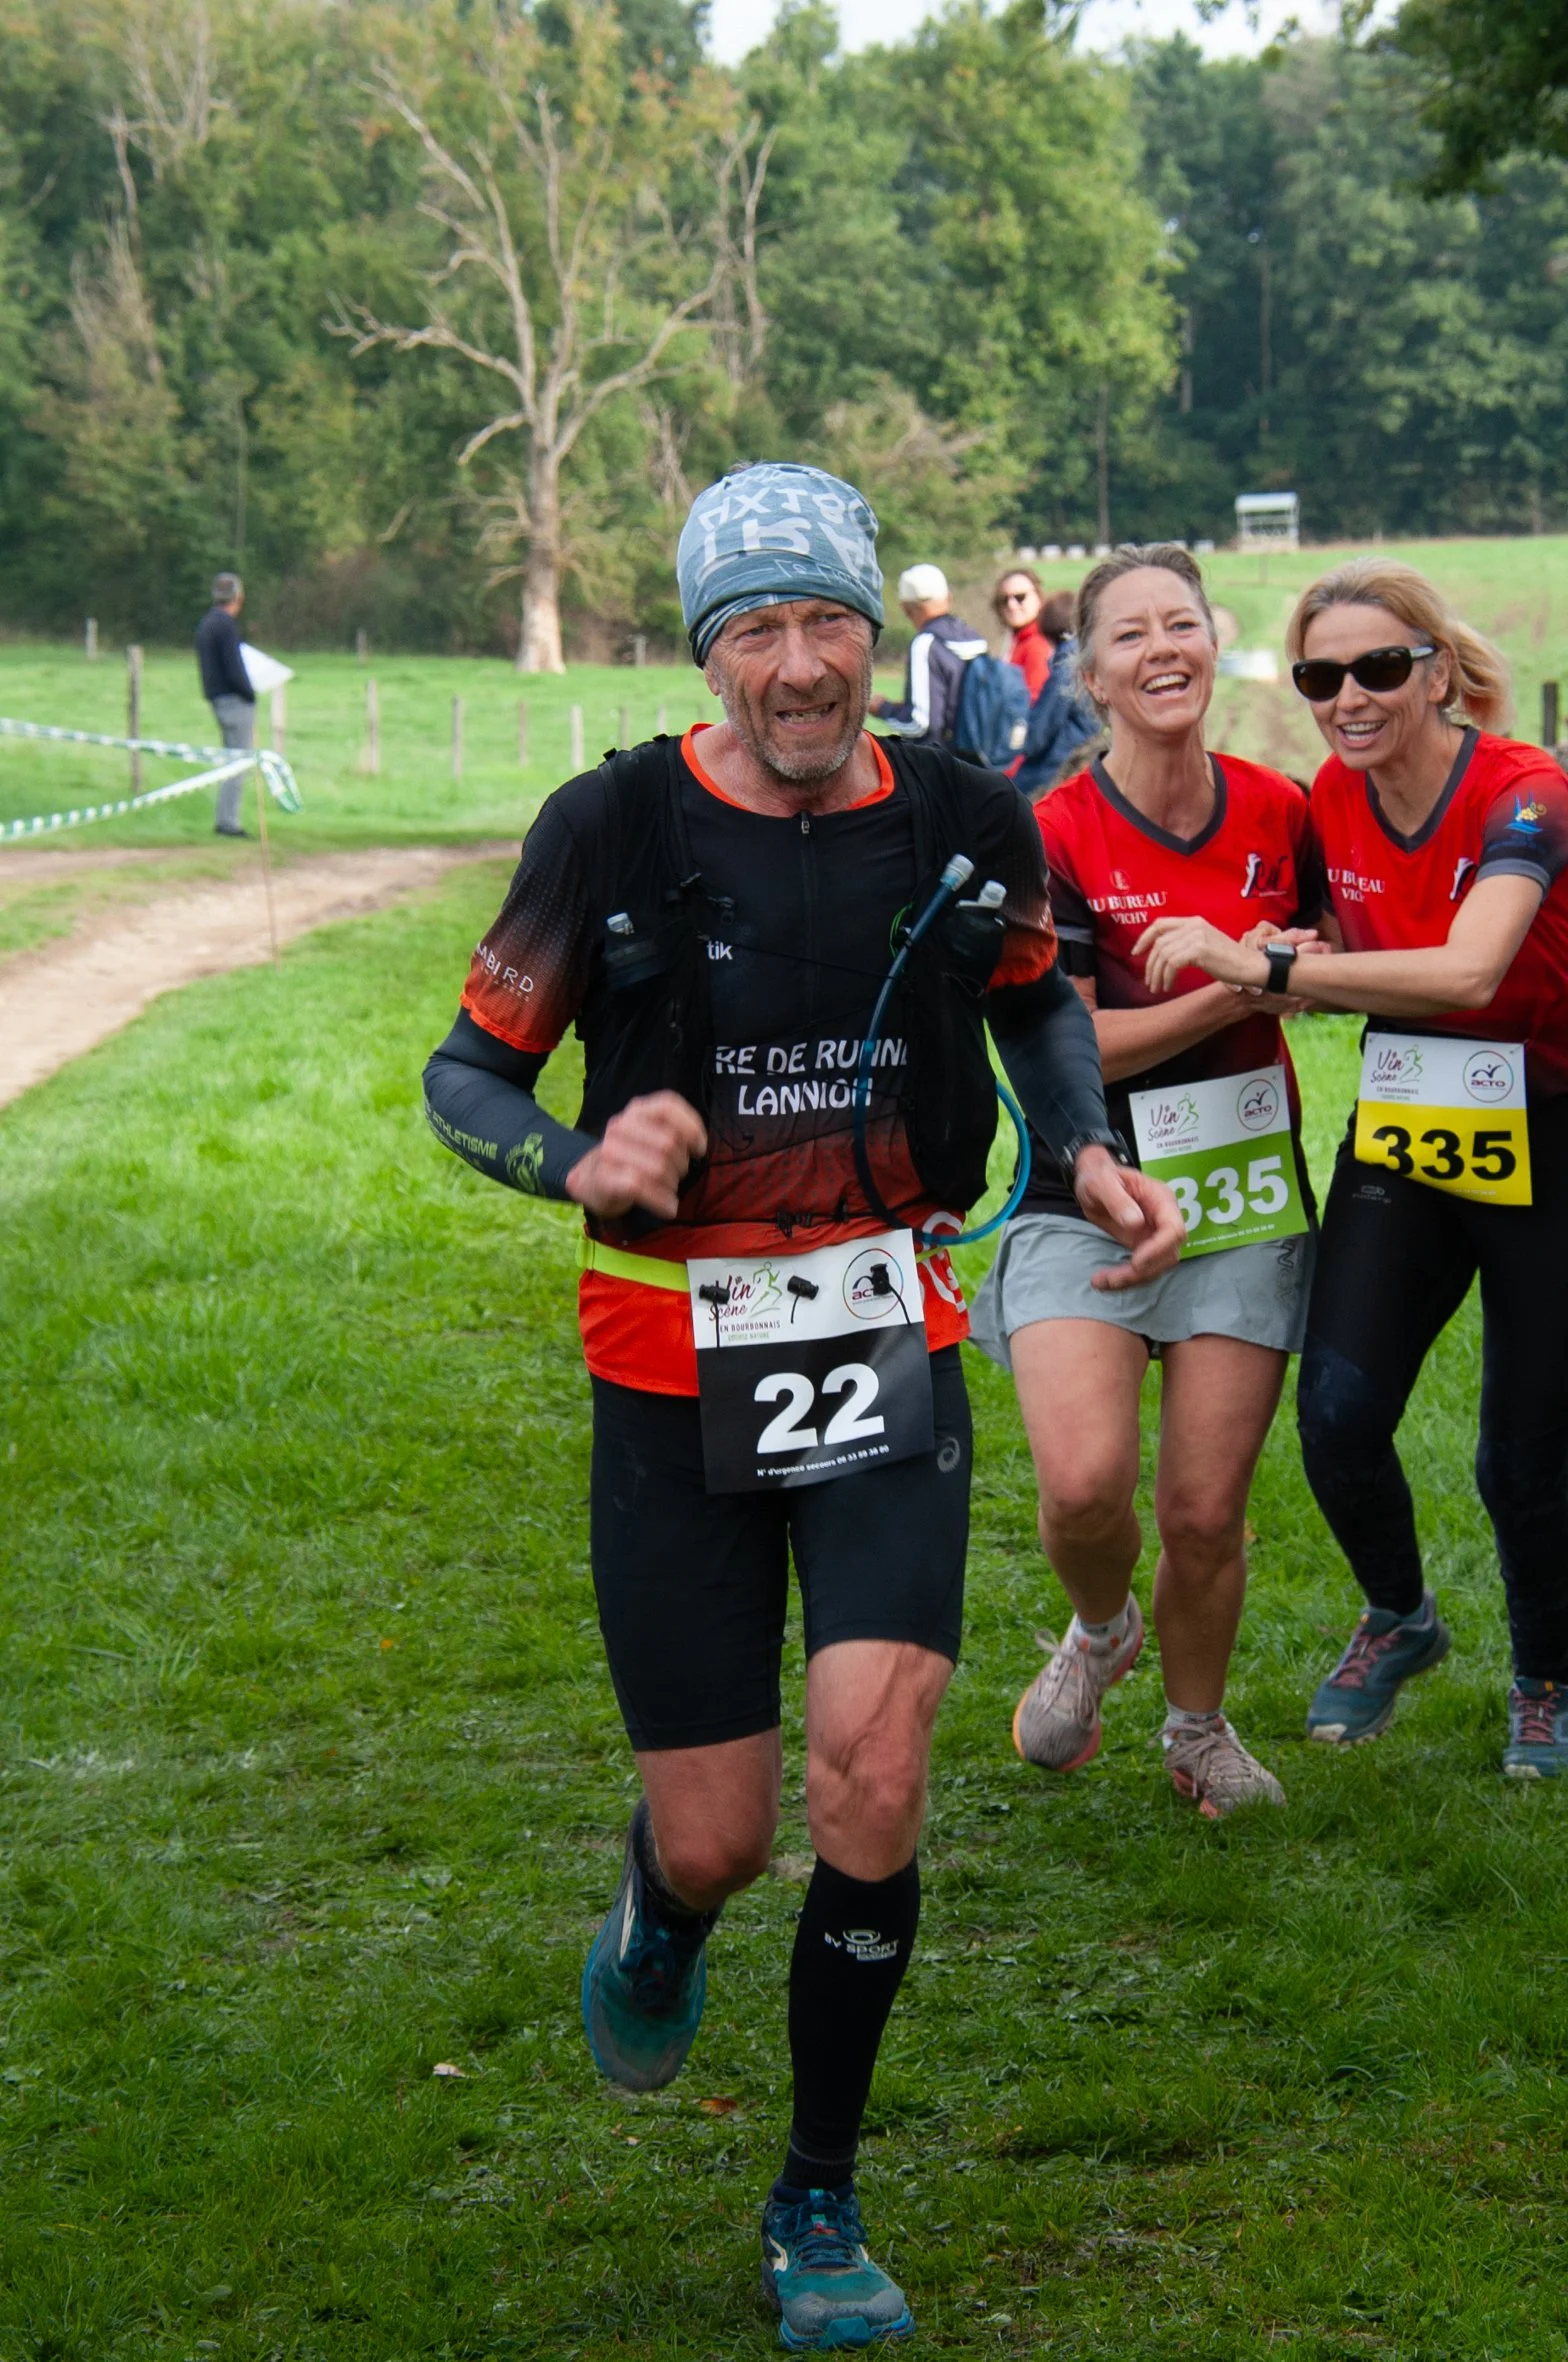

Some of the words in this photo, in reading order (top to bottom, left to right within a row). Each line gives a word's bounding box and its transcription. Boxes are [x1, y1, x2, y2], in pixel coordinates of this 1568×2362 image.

[1108, 891, 1167, 910] BUREAU
[1111, 911, 1148, 924] VICHY
[767, 1043, 807, 1075] DE
[1378, 1049, 1404, 1070] Vin
[1151, 1104, 1180, 1126] Vin
[1373, 1126, 1516, 1181] 335
[732, 1320, 780, 1331] BOURBONNAIS
[754, 1362, 885, 1454] 22
[846, 1940, 899, 1954] SPORT
